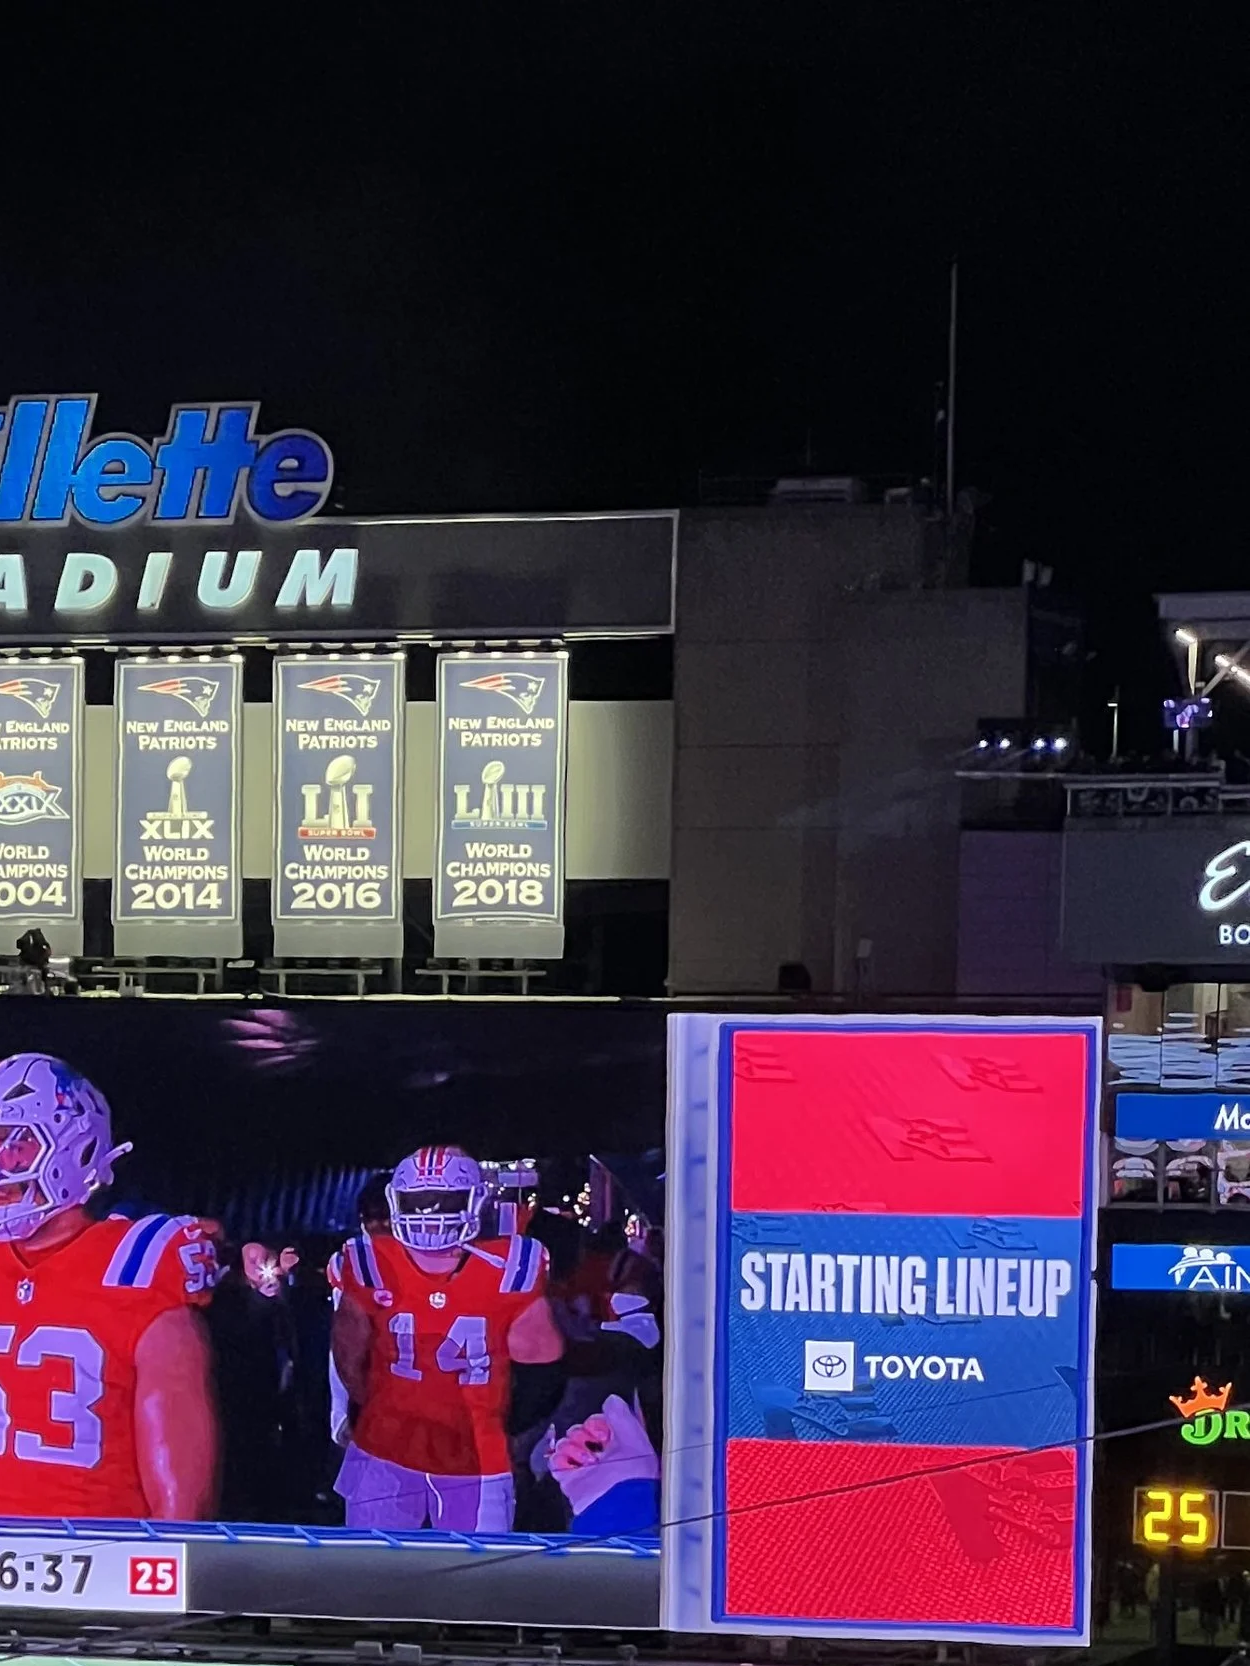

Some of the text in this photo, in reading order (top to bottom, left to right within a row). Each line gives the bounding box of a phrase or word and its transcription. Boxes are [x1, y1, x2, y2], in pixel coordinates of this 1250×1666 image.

[6, 720, 70, 734] ENGLAND
[126, 719, 229, 734] NEW ENGLAND
[285, 718, 390, 732] NEW ENGLAND
[448, 716, 555, 730] NEW ENGLAND
[138, 735, 217, 750] PATRIOTS
[298, 734, 378, 750] PATRIOTS
[460, 732, 542, 747] PATRIOTS
[453, 784, 546, 820] LIII
[140, 820, 214, 839] XLIX
[308, 829, 366, 837] SUPER BOWL
[470, 821, 529, 829] SUPER BOWL
[143, 845, 209, 862] WORLD
[303, 845, 370, 861] WORLD
[465, 843, 532, 858] WORLD
[125, 863, 228, 880] CHAMPIONS
[284, 863, 389, 880] CHAMPIONS
[446, 861, 550, 878] CHAMPIONS
[130, 882, 222, 910] 2014
[291, 882, 382, 910] 2016
[452, 879, 544, 907] 2018
[740, 1252, 1072, 1317] STARTING LINEUP
[388, 1312, 490, 1385] 14
[864, 1356, 985, 1382] TOYOTA
[1144, 1491, 1207, 1544] 25
[136, 1562, 174, 1592] 25
